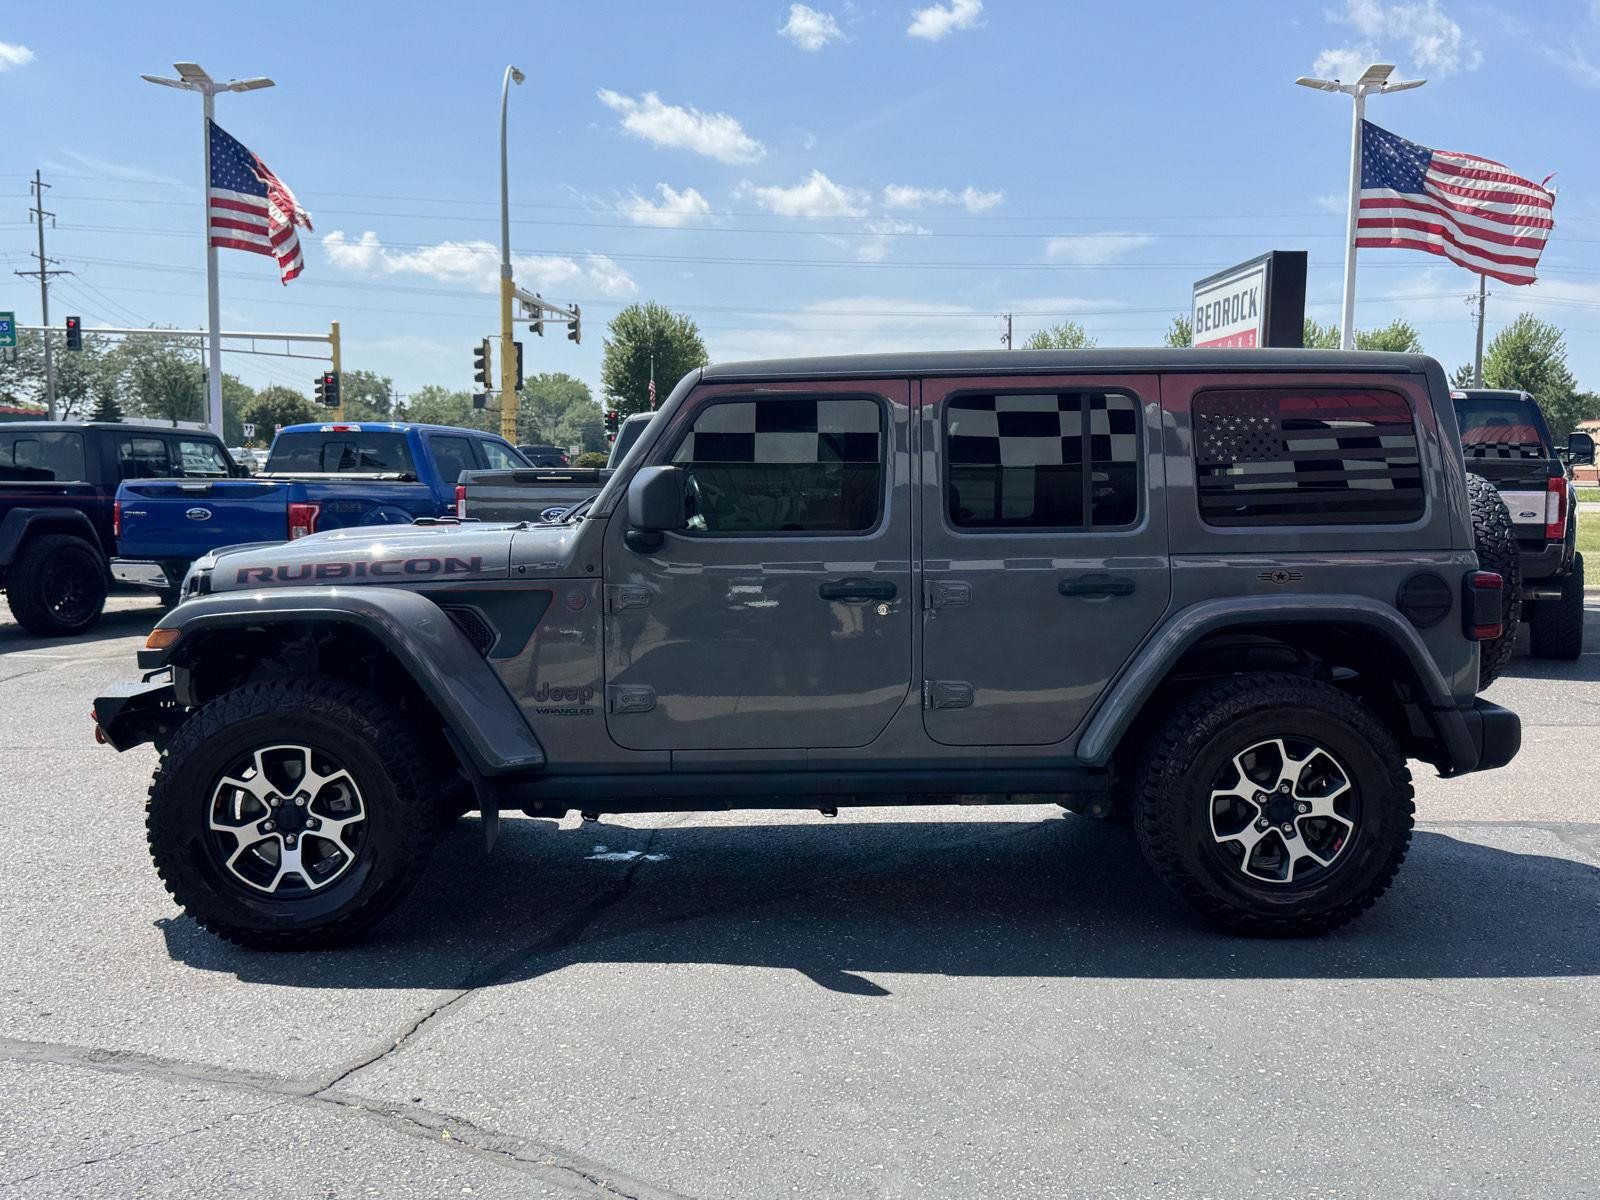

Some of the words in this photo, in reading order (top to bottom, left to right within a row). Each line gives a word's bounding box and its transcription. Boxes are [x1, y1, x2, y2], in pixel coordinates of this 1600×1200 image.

[1196, 286, 1258, 334] BEDROCK
[236, 556, 482, 584] RUBICON
[534, 682, 593, 705] Jeep
